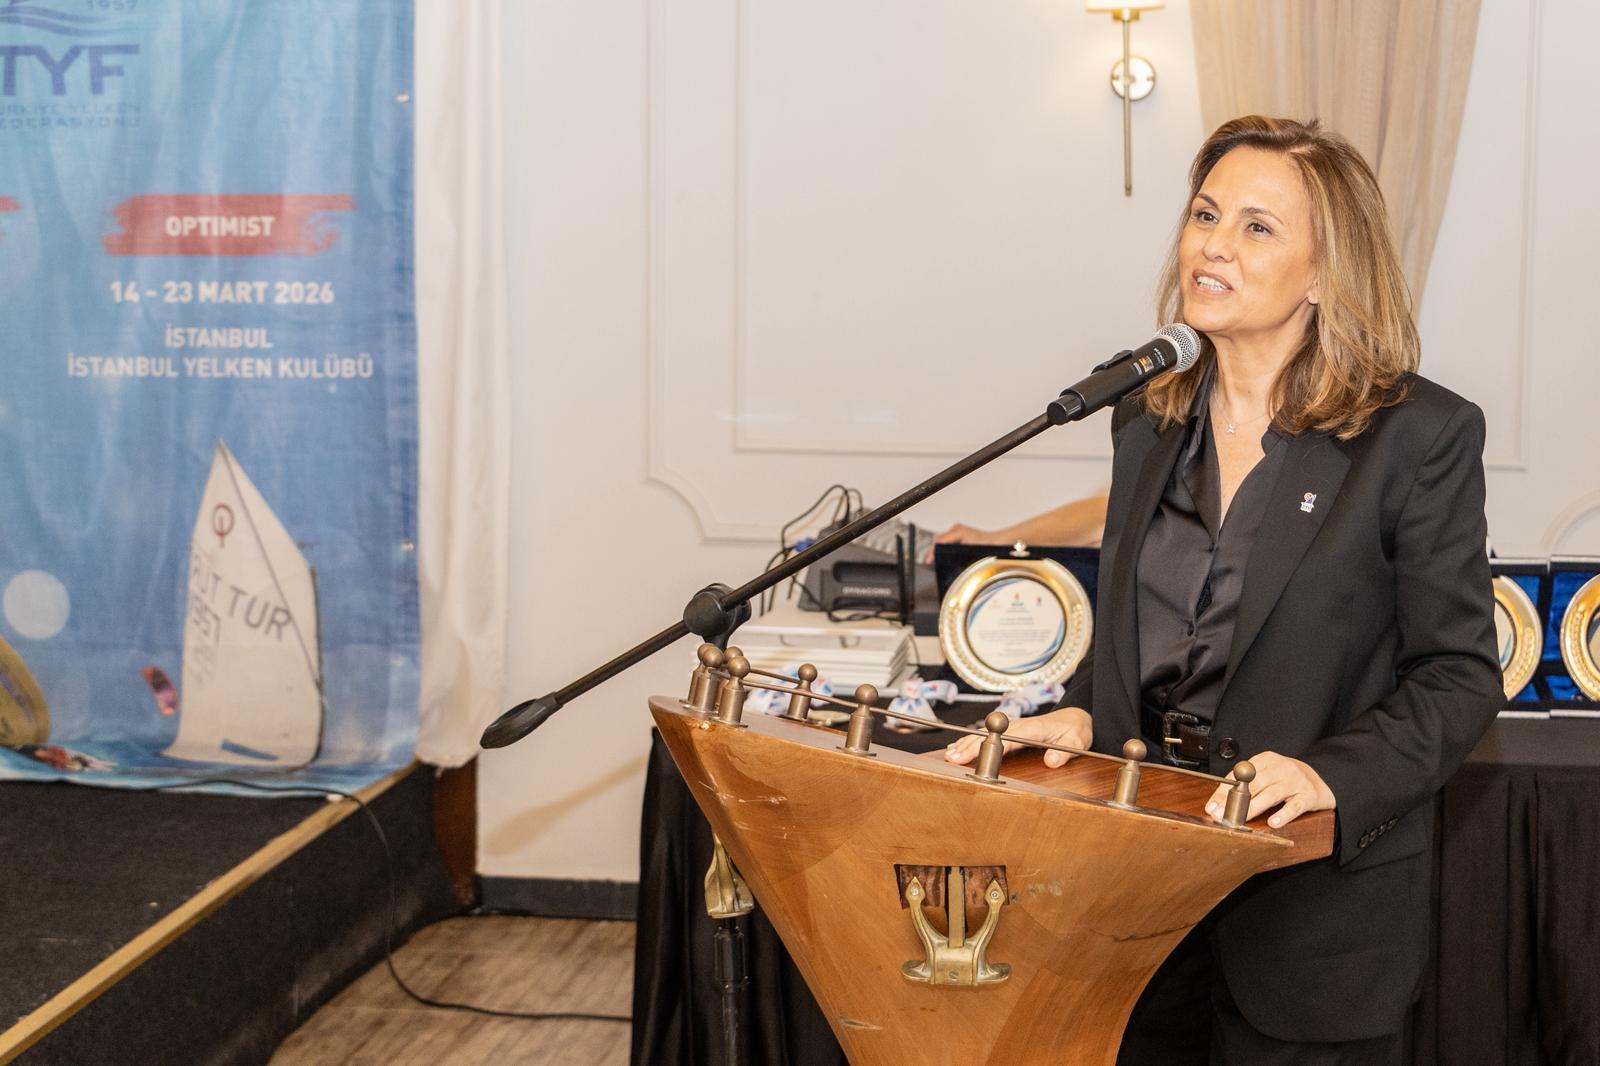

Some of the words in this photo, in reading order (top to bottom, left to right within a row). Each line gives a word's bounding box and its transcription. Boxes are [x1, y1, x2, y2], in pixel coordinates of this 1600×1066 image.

[0, 44, 140, 96] TYF
[165, 216, 276, 237] OPTIMIST
[110, 281, 140, 304] 14
[163, 281, 193, 304] 23
[198, 281, 270, 304] MART
[274, 281, 336, 305] 2026
[164, 325, 274, 349] İSTANBUL
[66, 352, 179, 378] İSTANBUL
[183, 356, 273, 379] YELKEN
[277, 353, 375, 379] KULÜBÜ
[229, 585, 294, 642] TUR
